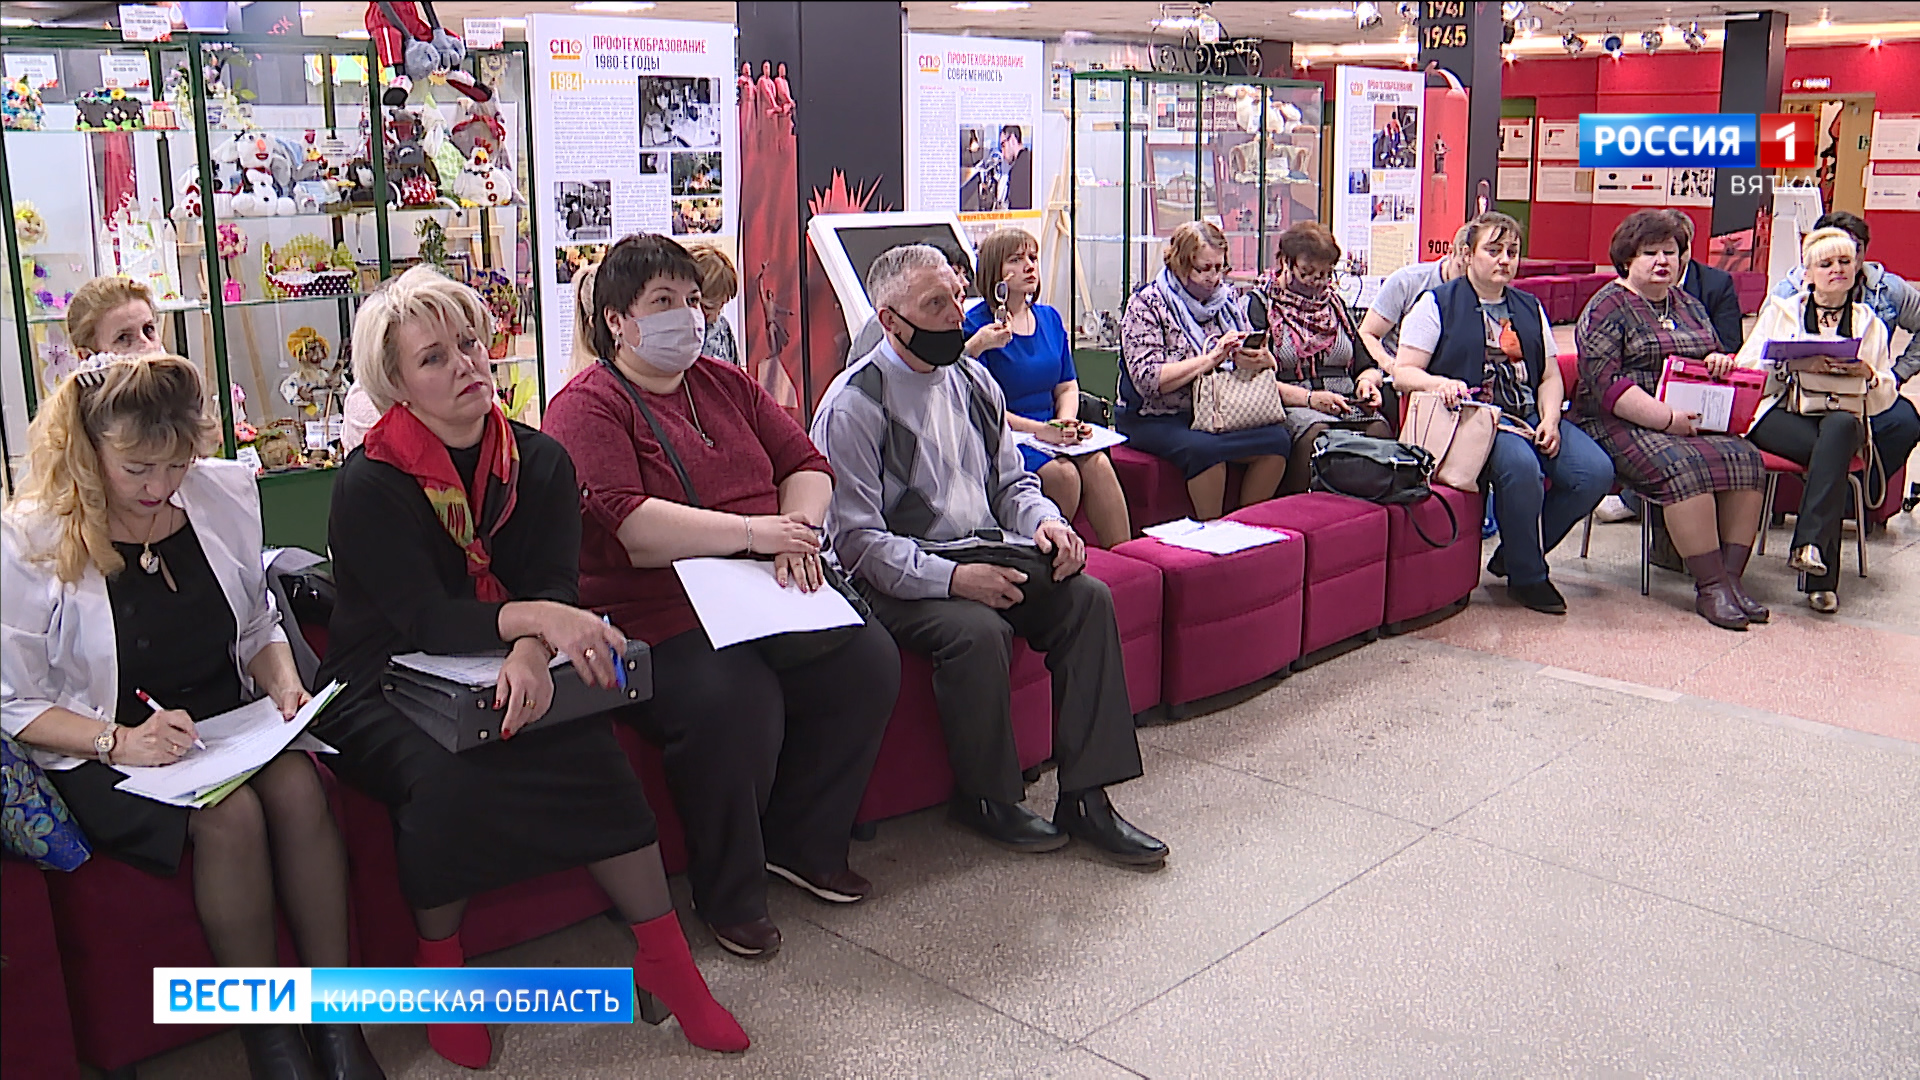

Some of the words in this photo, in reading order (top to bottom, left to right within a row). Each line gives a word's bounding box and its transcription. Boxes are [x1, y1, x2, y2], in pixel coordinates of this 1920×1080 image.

[593, 35, 707, 54] ПРОФТЕХОБРАЗОВАНИЕ
[1423, 25, 1467, 48] 1945
[550, 38, 583, 54] СПО
[595, 55, 629, 70] 1980-Е
[631, 56, 661, 71] ГОДЫ
[551, 72, 582, 91] 1984
[947, 67, 1003, 82] СОВРЕМЕННОСТЬ
